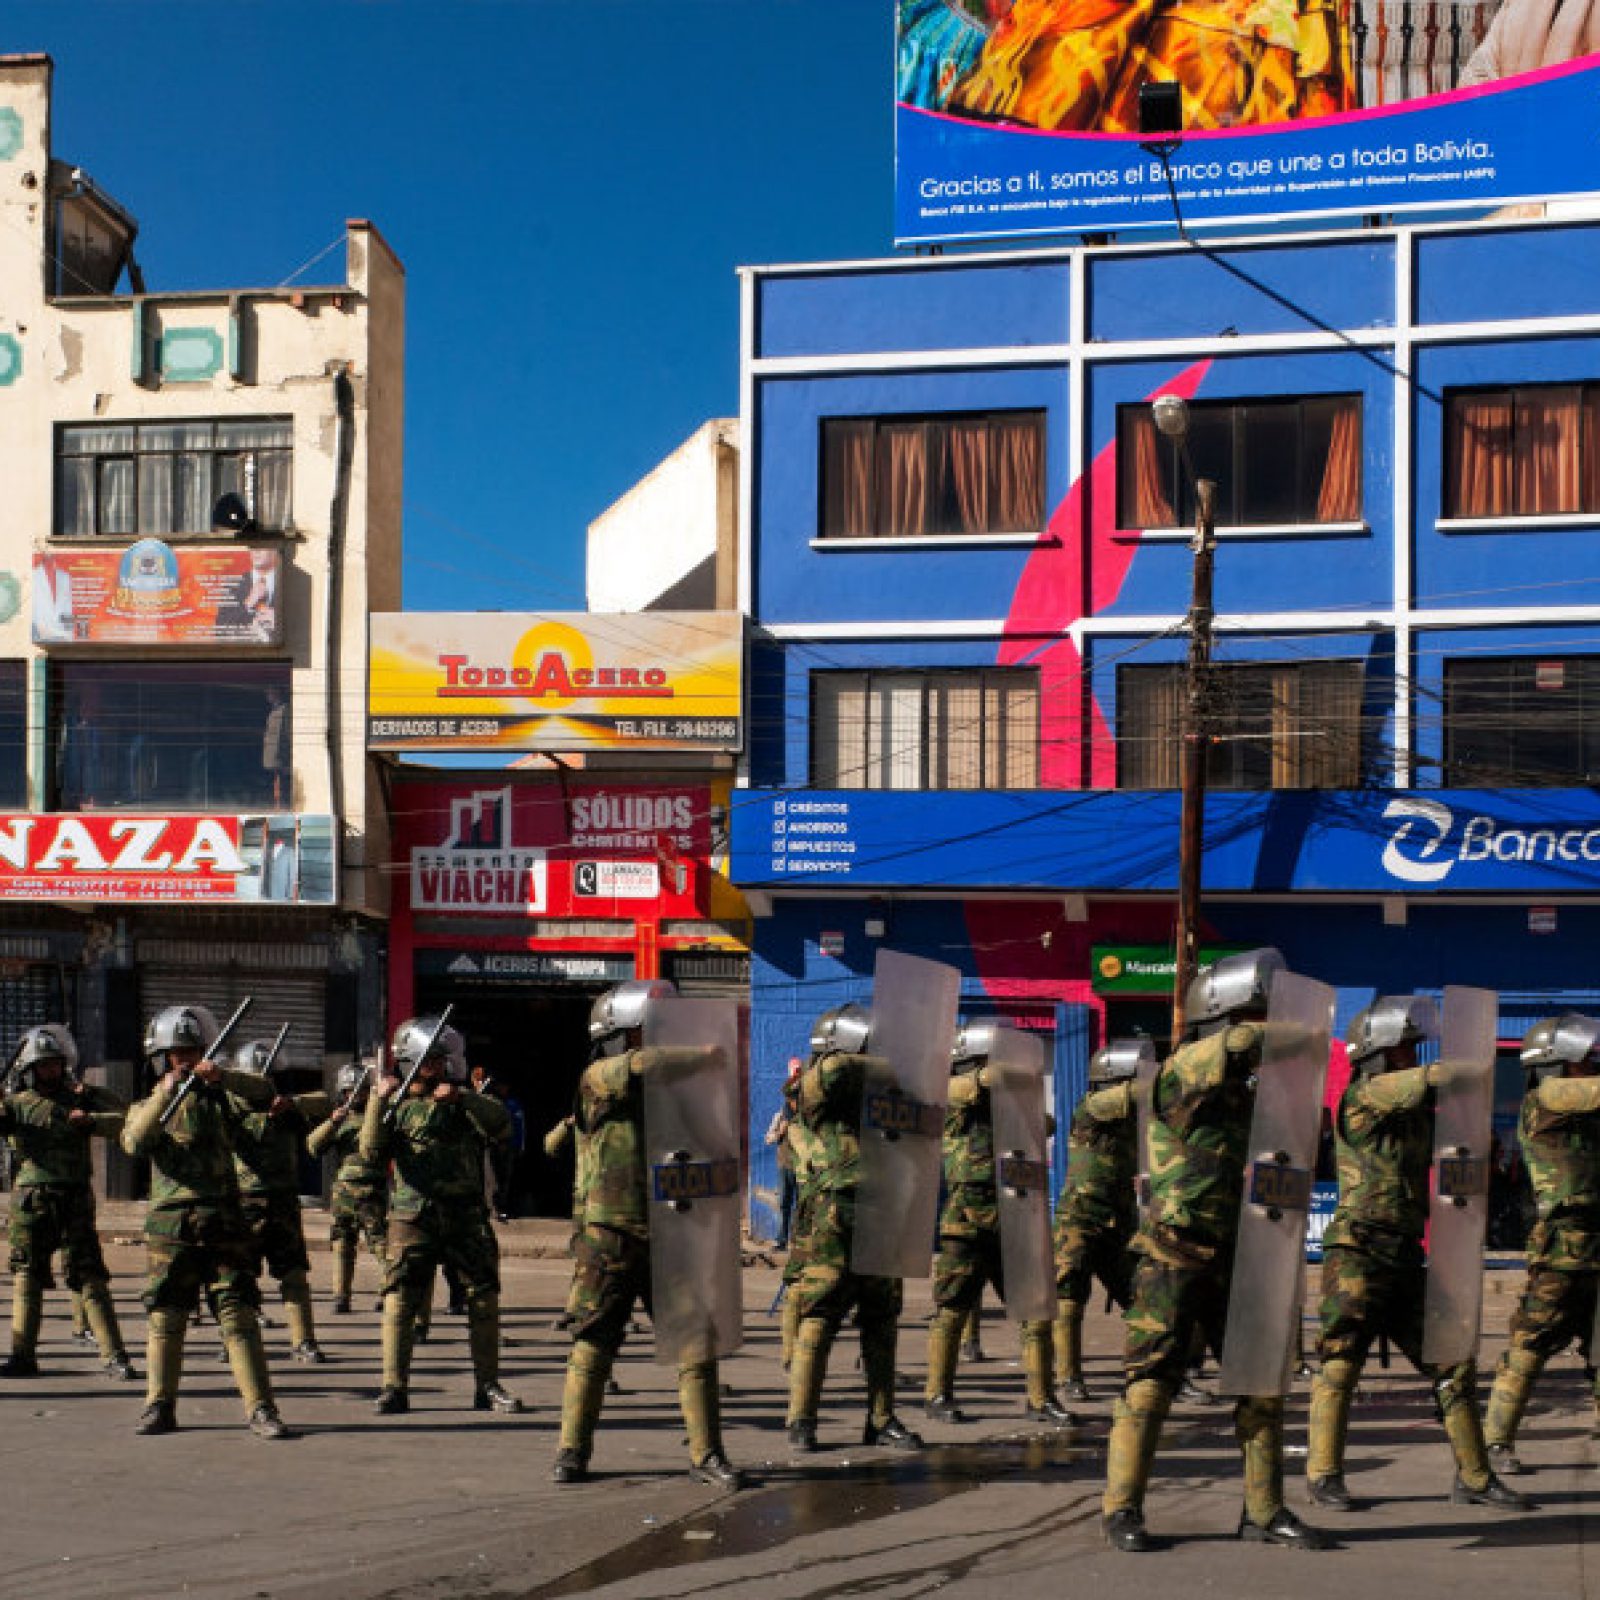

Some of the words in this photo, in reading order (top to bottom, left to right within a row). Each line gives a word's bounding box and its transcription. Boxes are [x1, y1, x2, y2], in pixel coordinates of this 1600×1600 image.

[920, 174, 1001, 198] Gracias
[1006, 177, 1023, 192] a
[1051, 169, 1119, 190] somos
[1124, 164, 1143, 184] el
[1149, 160, 1223, 183] Banco
[1227, 160, 1273, 181] que
[1279, 156, 1324, 175] une
[1329, 154, 1346, 169] a
[1351, 145, 1409, 168] toda
[572, 790, 693, 830] SÓLIDOS
[420, 869, 536, 904] VIACHA
